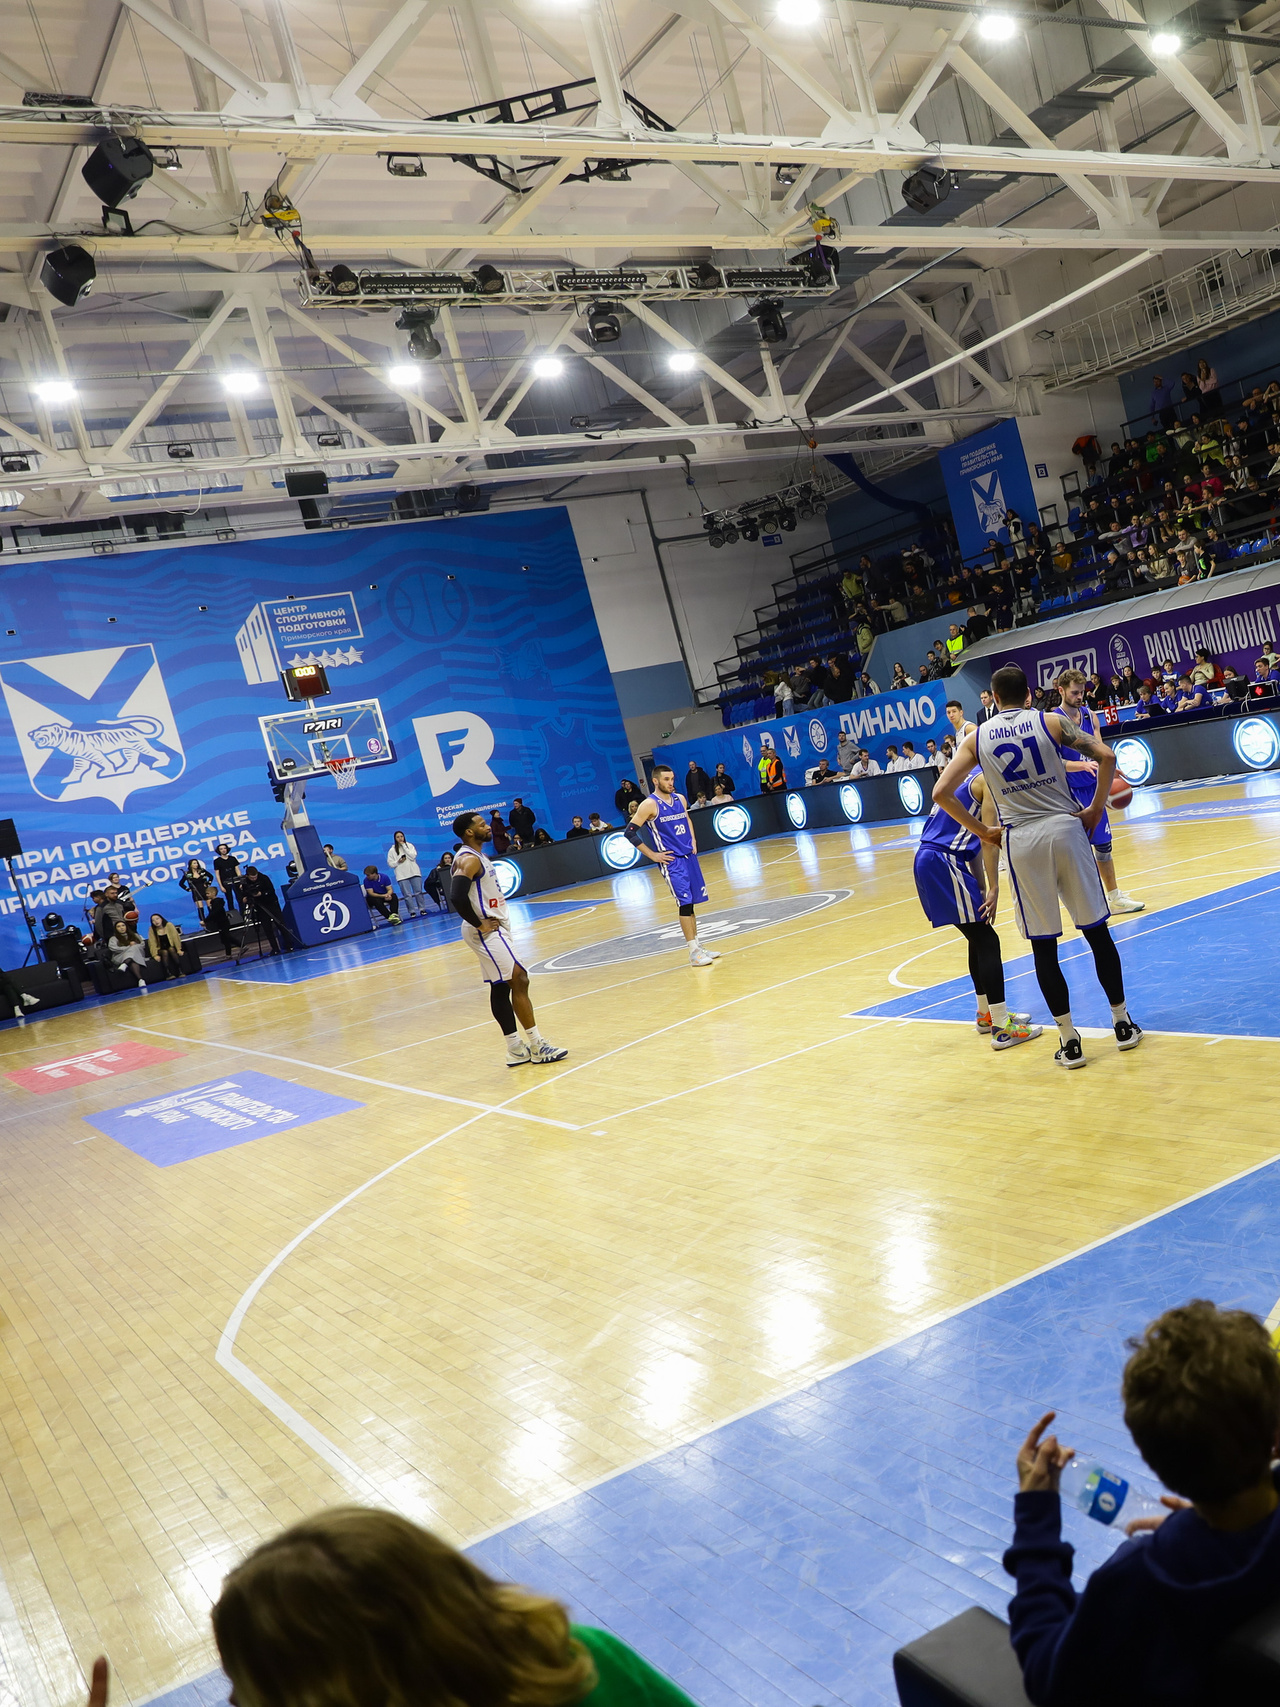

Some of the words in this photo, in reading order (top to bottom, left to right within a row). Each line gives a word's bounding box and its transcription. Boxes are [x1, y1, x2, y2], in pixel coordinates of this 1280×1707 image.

[273, 604, 308, 616] ЦЕНТР
[275, 608, 346, 624] СПОРТИВНОЙ
[278, 618, 347, 633] ПОДГОТОВКИ
[281, 630, 333, 642] Приморского
[334, 628, 352, 636] края
[1142, 628, 1181, 668] PARI
[304, 718, 342, 733] PARI
[839, 695, 936, 745] ДИНАМО
[989, 721, 1034, 740] СМЫГИН
[992, 735, 1047, 783] 21
[555, 761, 597, 787] 25
[1001, 775, 1058, 796] ВЛАДИВОСТОК
[436, 803, 464, 813] Русская
[673, 824, 686, 836] 28
[3, 844, 67, 872] ПРИ
[70, 810, 251, 858] ПОДДЕРЖКЕ
[8, 830, 258, 891] ПРАВИТЕЛЬСТВА
